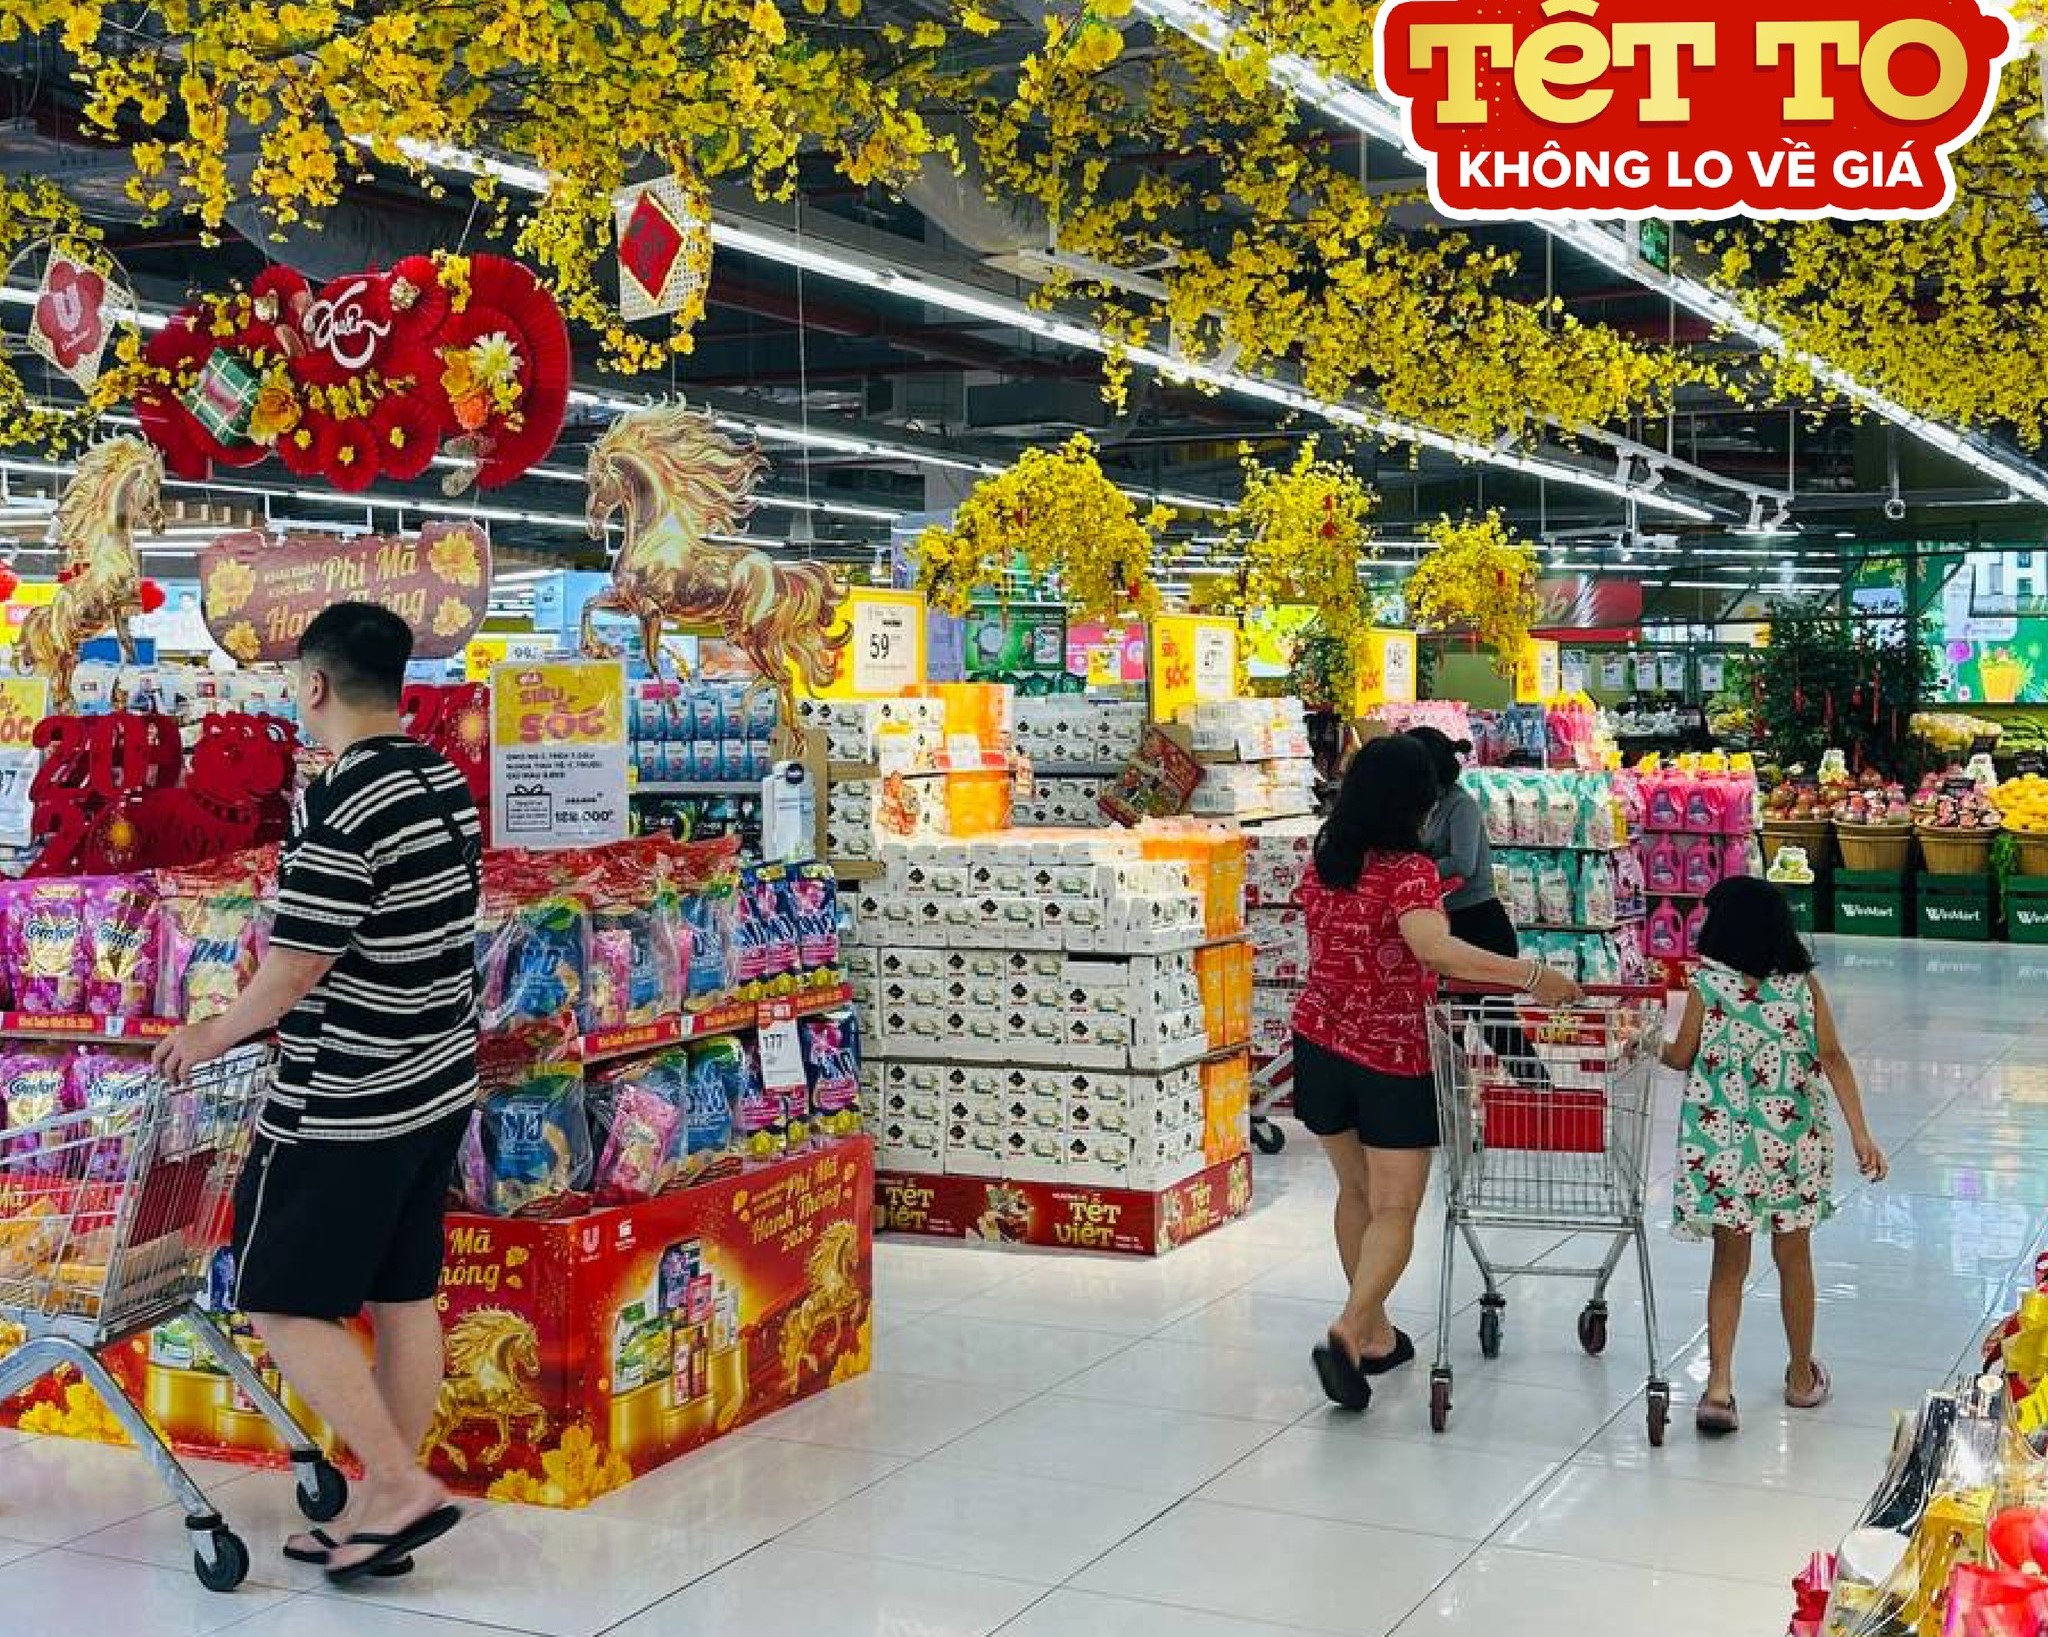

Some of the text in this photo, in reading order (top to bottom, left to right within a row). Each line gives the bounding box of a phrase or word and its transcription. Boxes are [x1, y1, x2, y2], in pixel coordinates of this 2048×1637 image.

[323, 550, 367, 593] Phi
[1841, 902, 1895, 918] WinMart
[1926, 906, 1982, 922] WinMart
